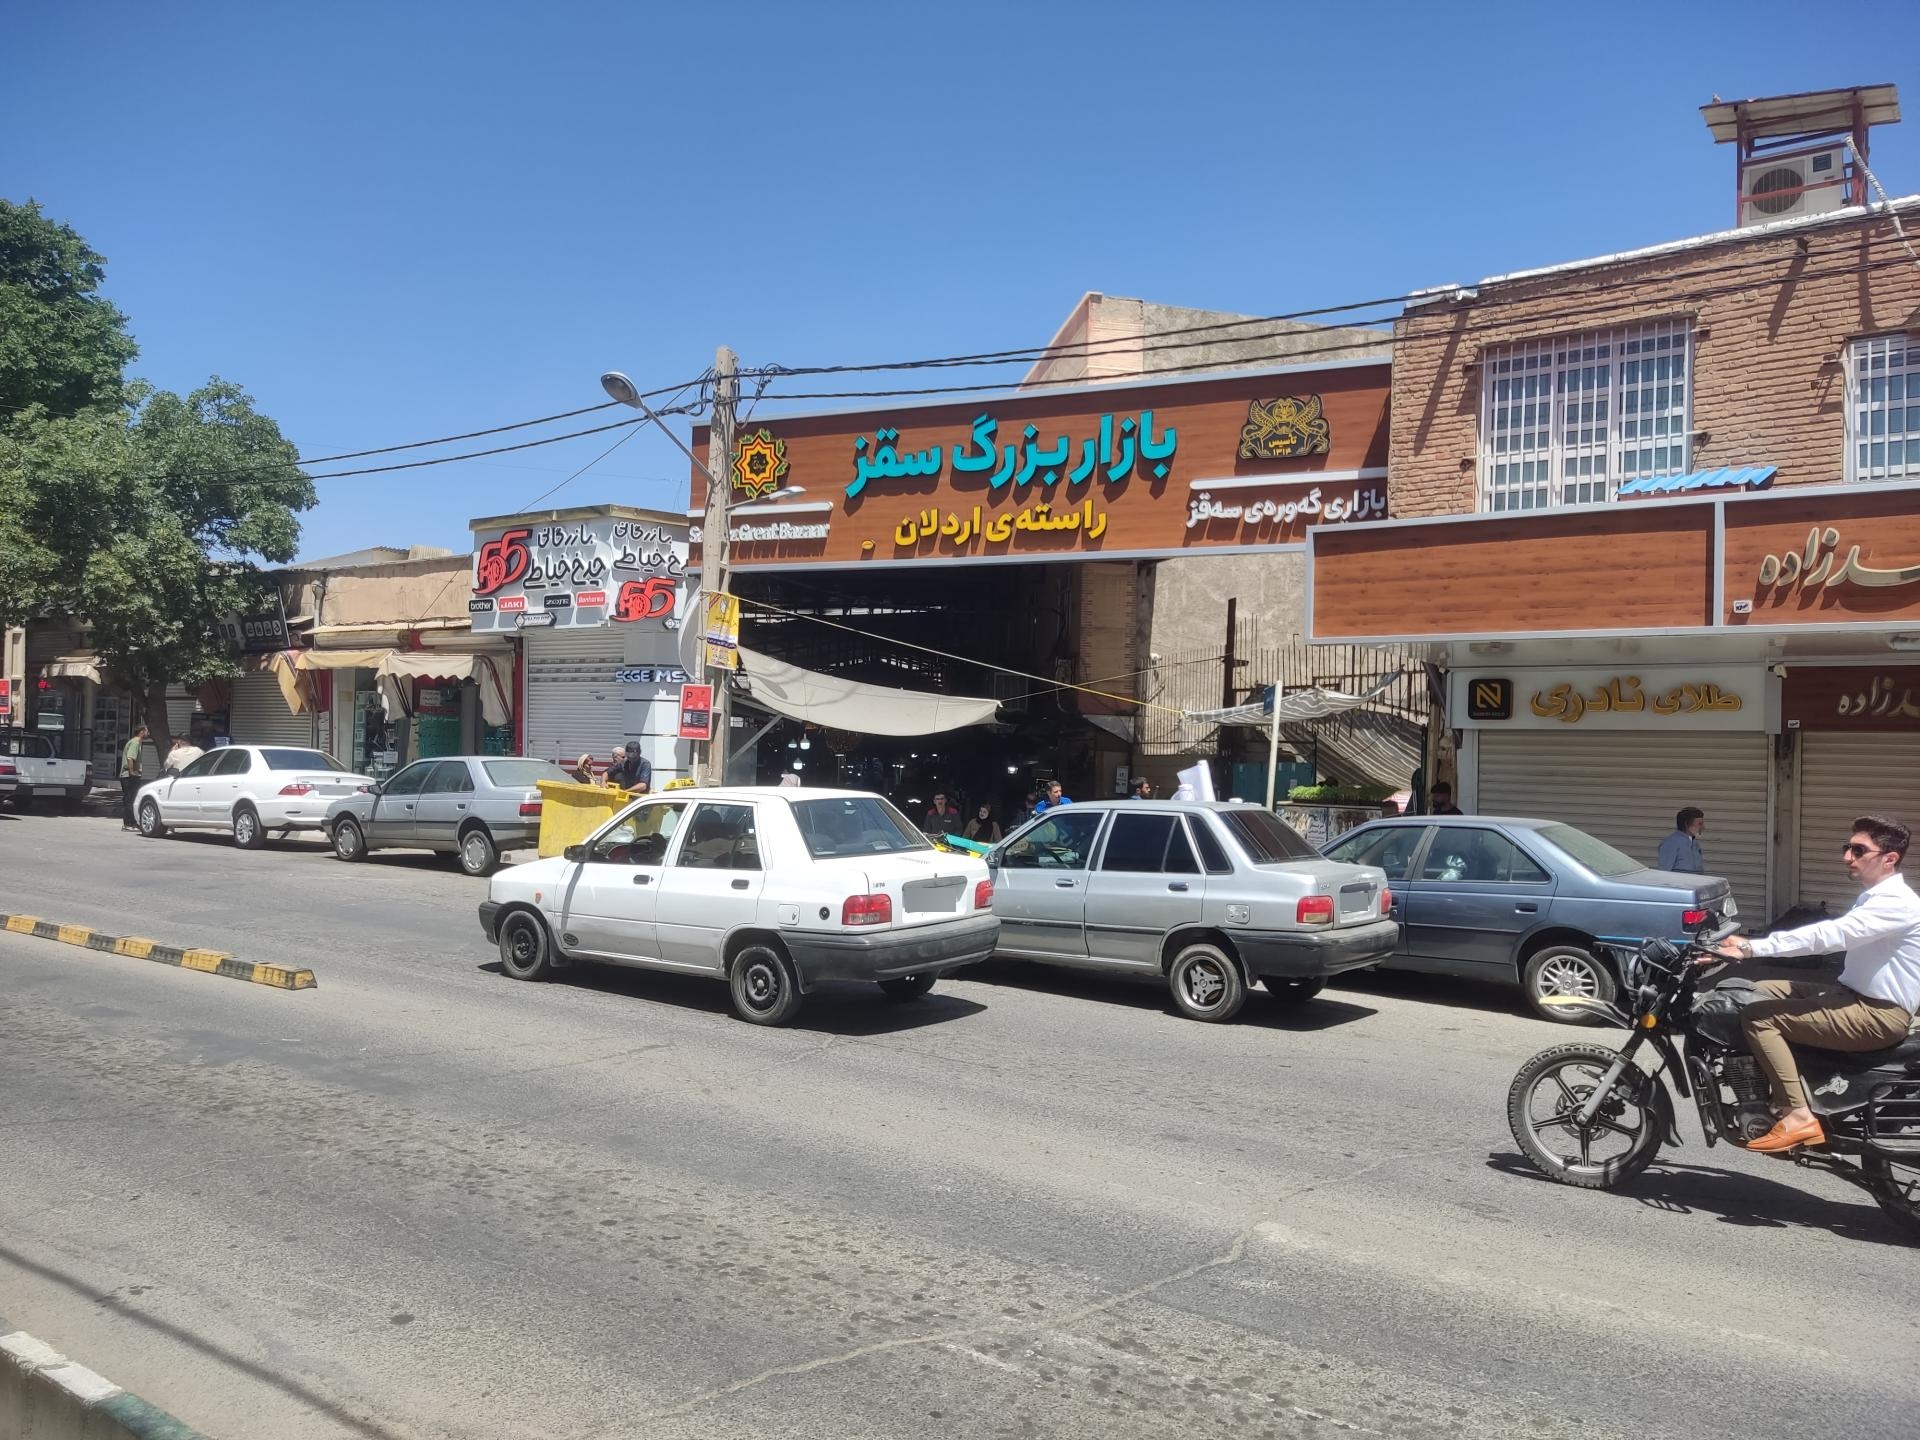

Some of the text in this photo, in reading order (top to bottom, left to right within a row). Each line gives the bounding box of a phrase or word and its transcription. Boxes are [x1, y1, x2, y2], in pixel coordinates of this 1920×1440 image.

[845, 409, 1177, 499] بازار بزرگ سقز
[739, 523, 778, 542] Great
[778, 522, 830, 540] Bazaar
[895, 505, 982, 545] اردلان
[470, 600, 492, 611] brother
[1531, 676, 1742, 723] طلای نادری
